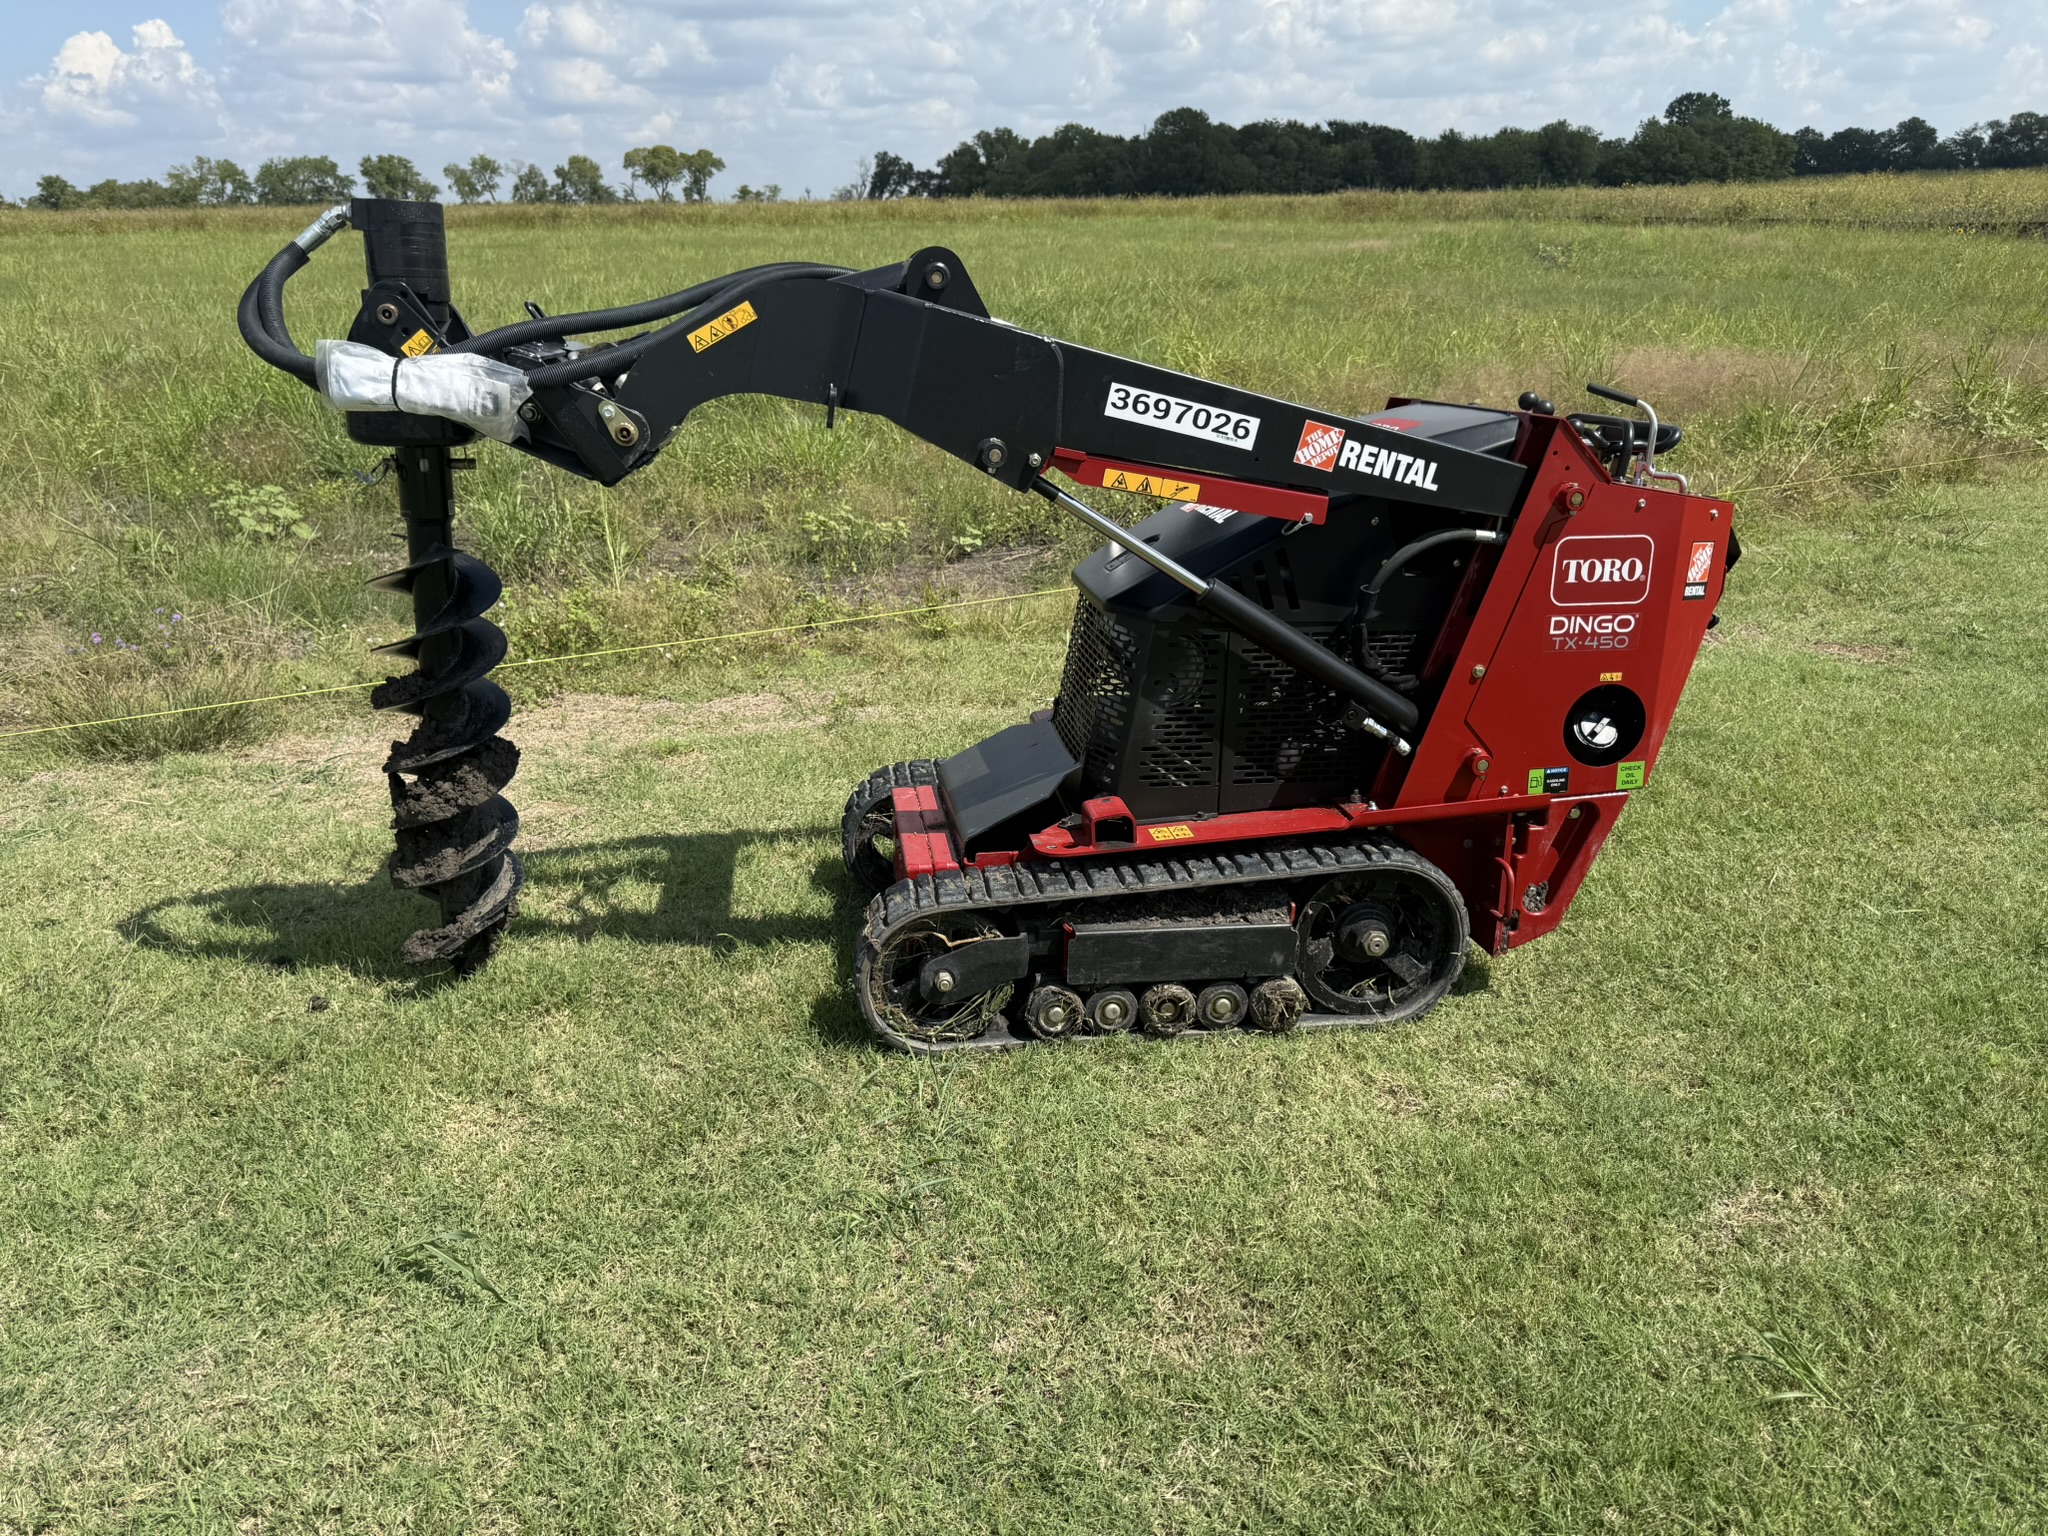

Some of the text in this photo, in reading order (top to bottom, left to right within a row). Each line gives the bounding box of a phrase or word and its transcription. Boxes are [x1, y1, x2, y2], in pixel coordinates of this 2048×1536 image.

[1111, 388, 1250, 440] 3697026
[1296, 429, 1343, 464] HOME
[1304, 428, 1325, 443] THE
[1310, 444, 1338, 467] DEPOT
[1338, 439, 1439, 491] RENTAL
[1562, 557, 1643, 584] TORO
[1684, 585, 1705, 596] RENTAL
[1549, 614, 1636, 635] DINGO
